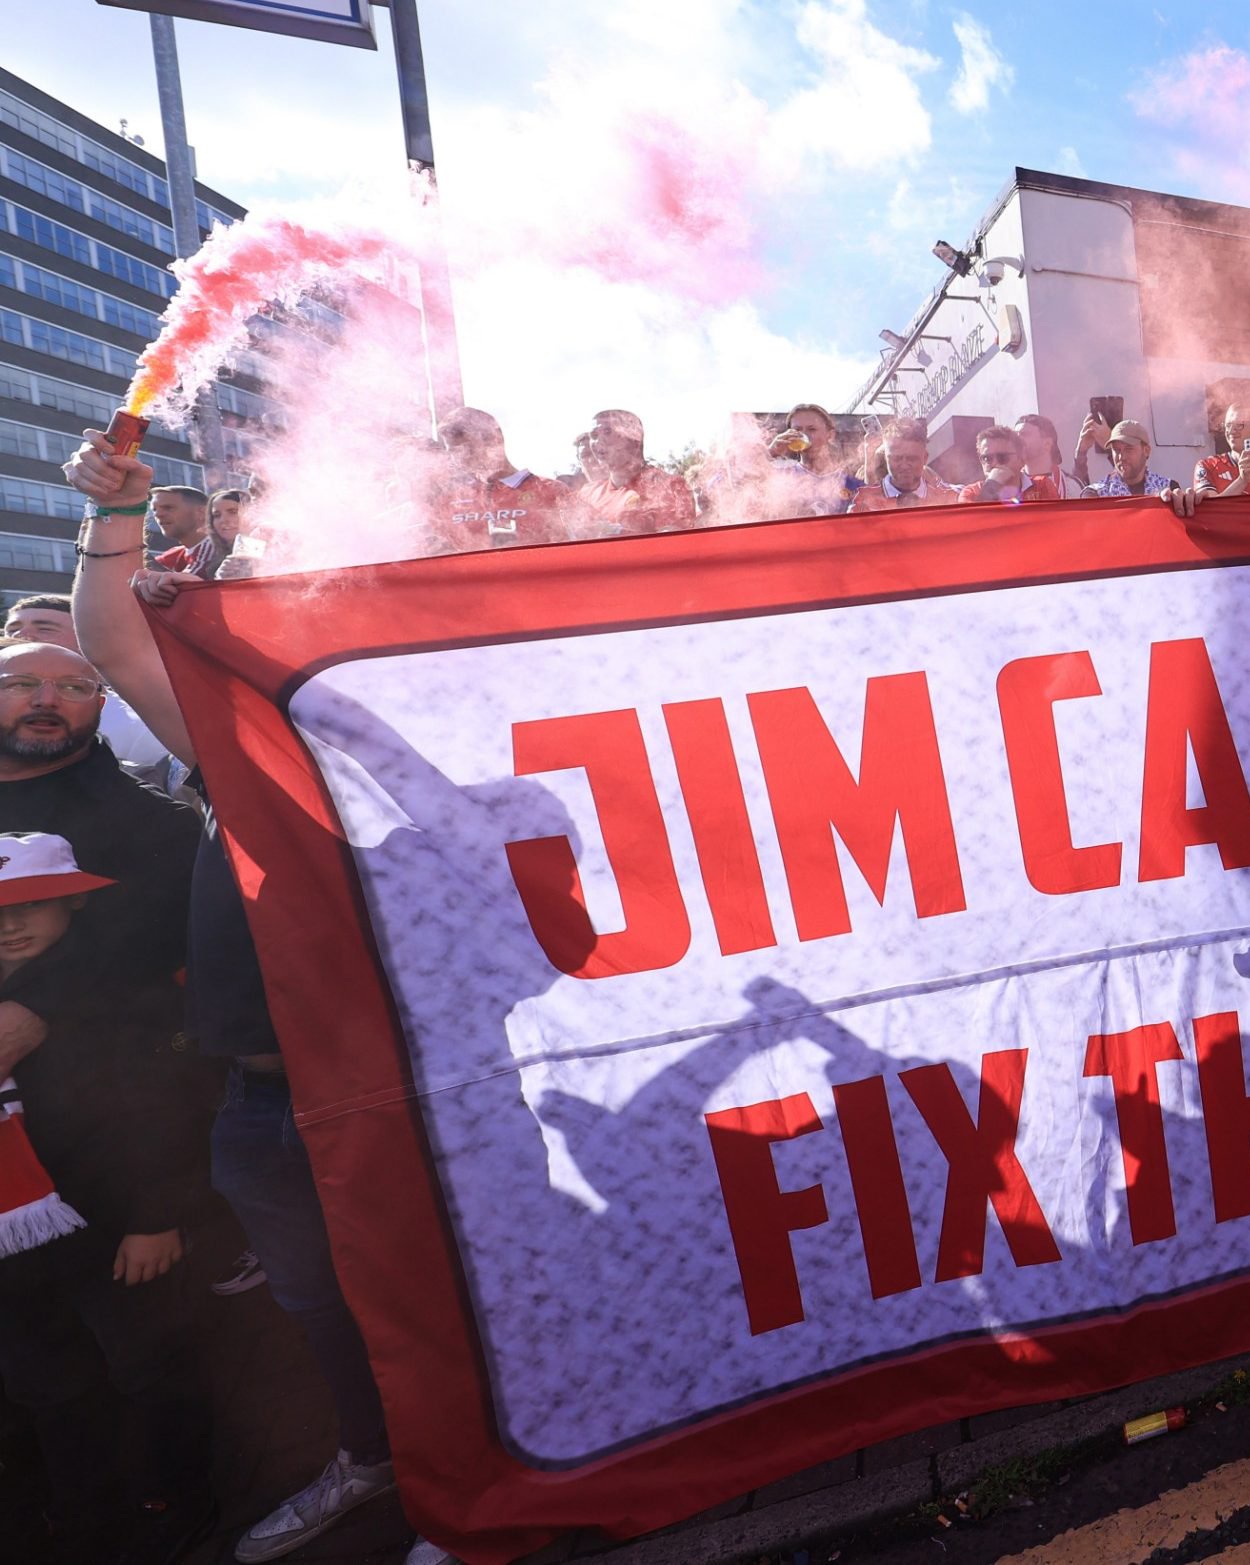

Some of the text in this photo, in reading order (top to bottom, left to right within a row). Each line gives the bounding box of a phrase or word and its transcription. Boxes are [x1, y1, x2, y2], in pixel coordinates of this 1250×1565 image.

[452, 509, 527, 524] SHARP
[504, 670, 967, 980] JIM
[704, 1047, 1063, 1337] FIX
